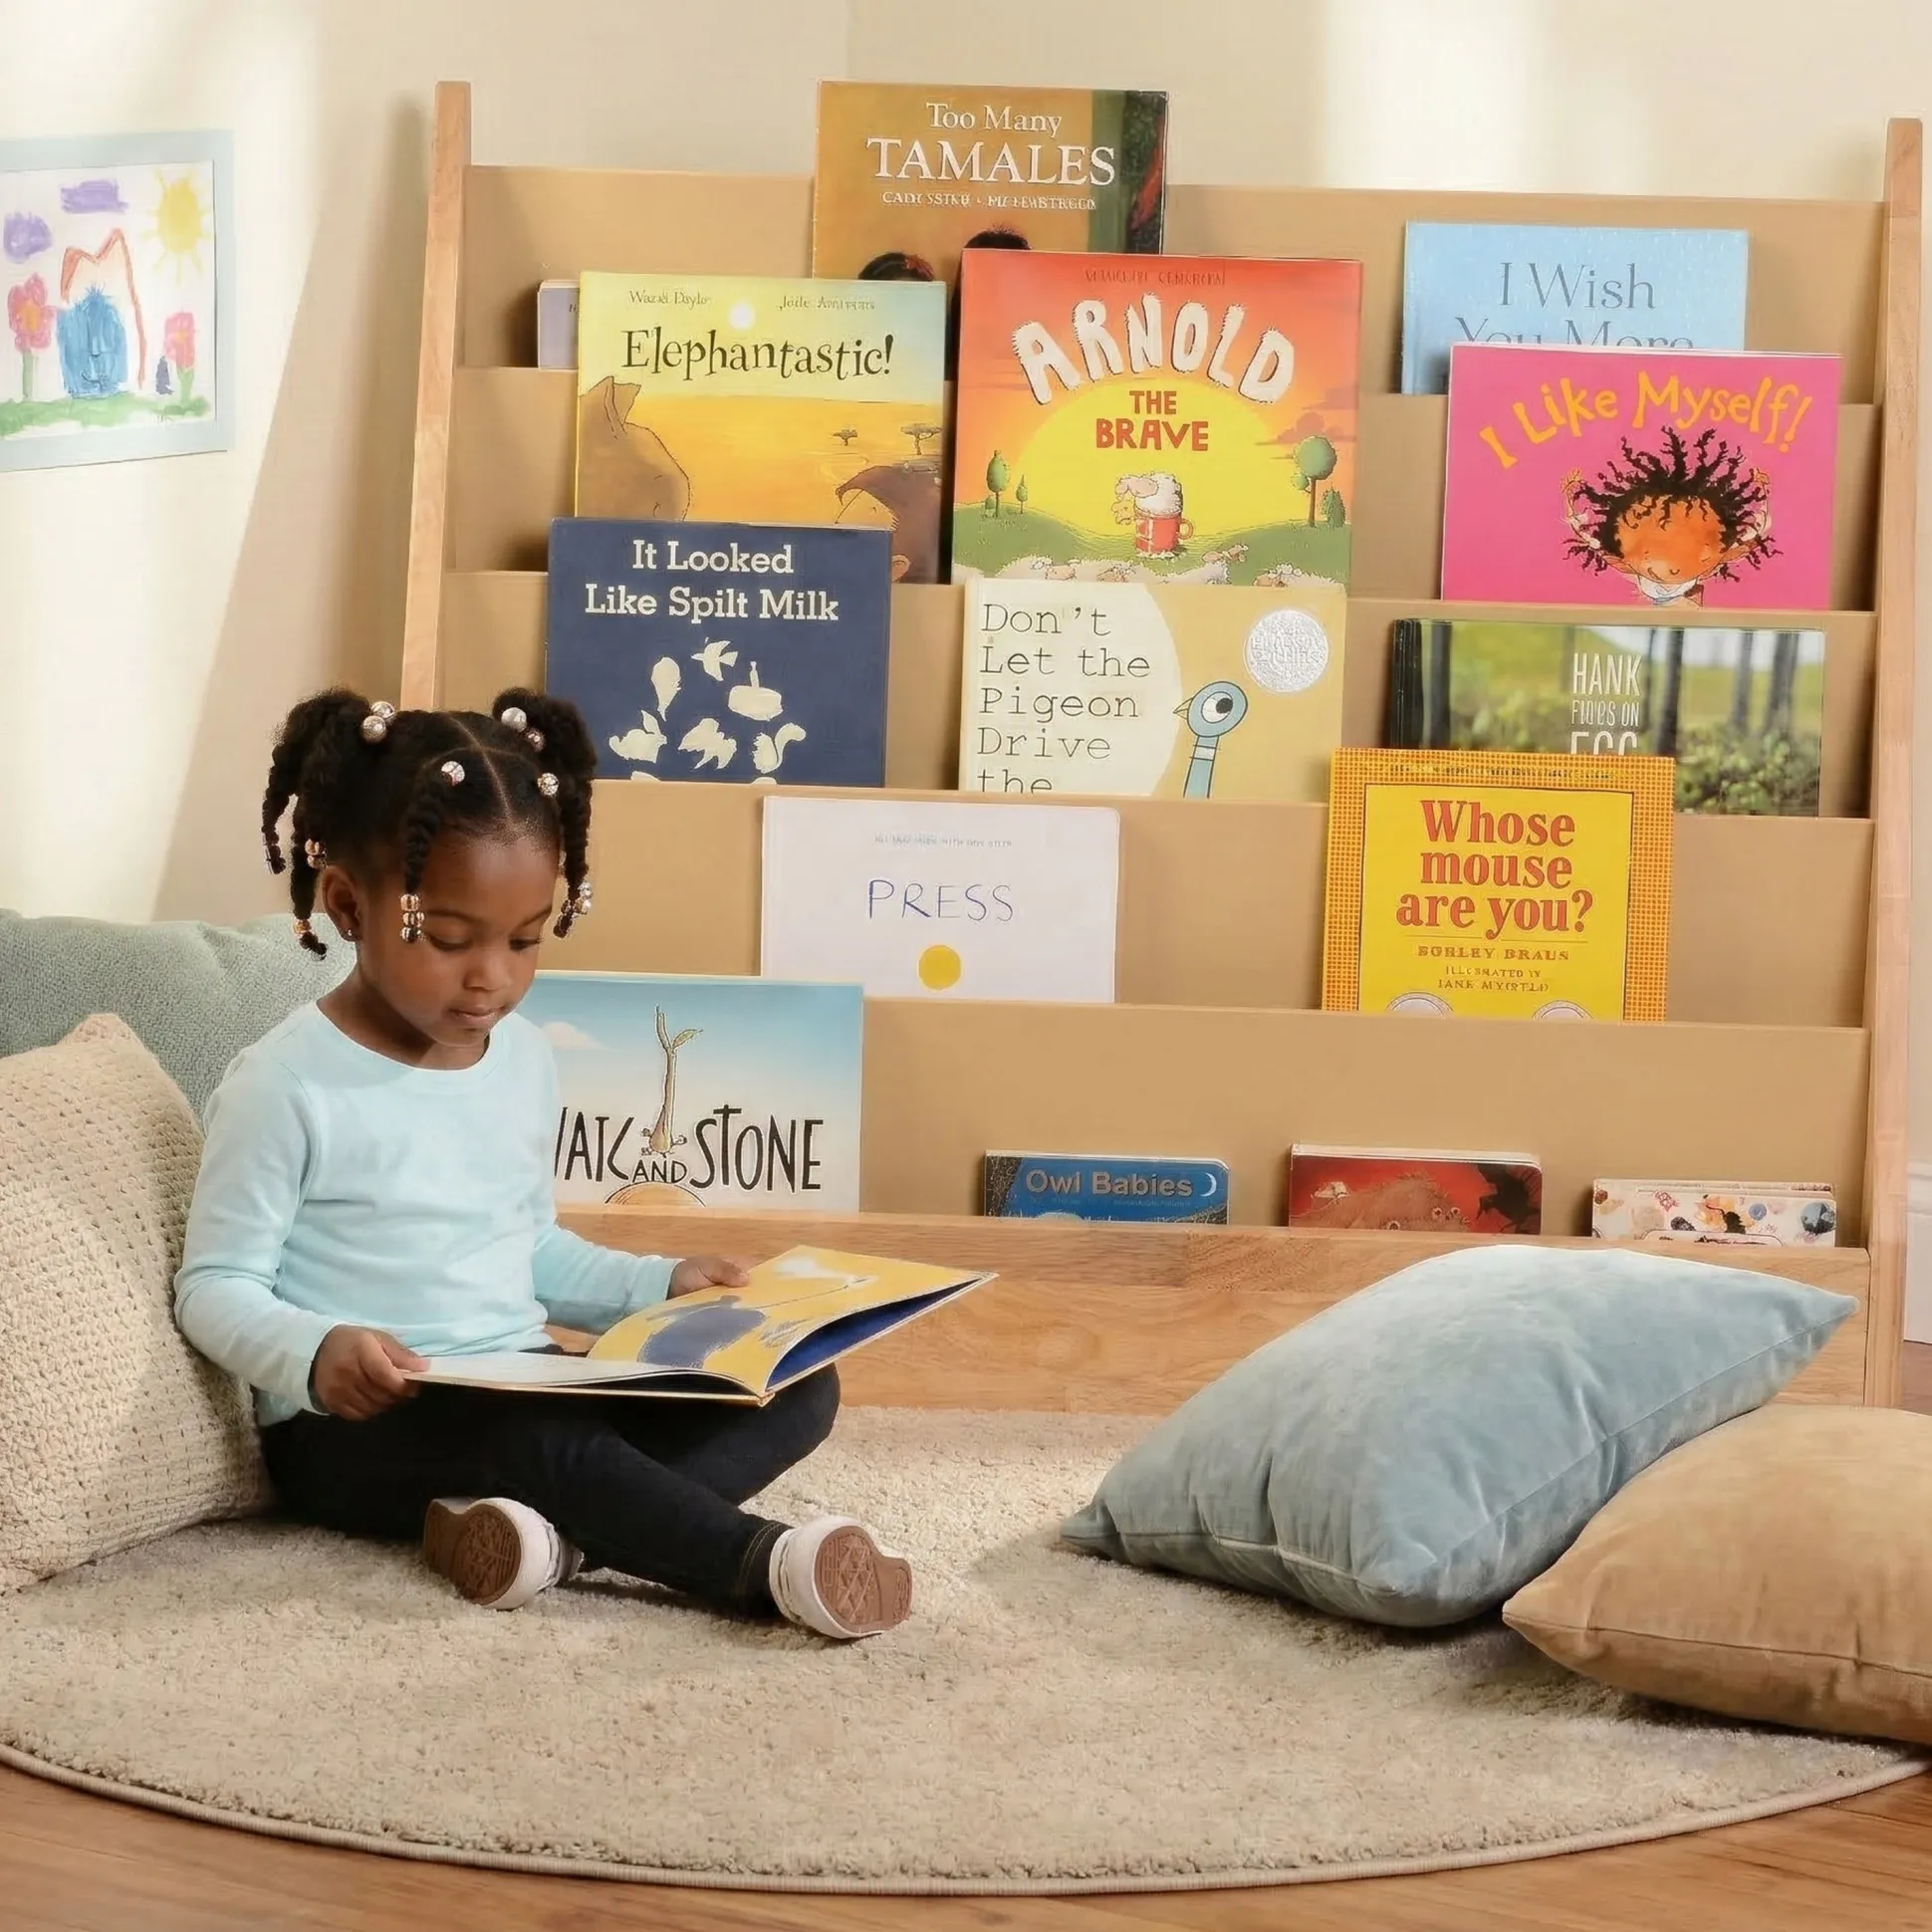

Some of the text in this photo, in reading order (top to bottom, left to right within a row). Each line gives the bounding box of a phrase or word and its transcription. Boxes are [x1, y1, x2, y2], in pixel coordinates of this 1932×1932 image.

[926, 102, 1062, 137] Too Many
[866, 137, 1115, 186] TAMALES
[1499, 262, 1656, 310] I Wish
[621, 327, 895, 380] Elephantastic!
[1011, 291, 1296, 405] ARNOLD
[1128, 390, 1177, 415] THE
[1479, 369, 1813, 470] I Like Myself!
[1095, 418, 1209, 451] BRAVE
[632, 539, 794, 575] It Looked
[585, 584, 840, 624] Like Spilt Milk
[981, 604, 1111, 636] Don't
[980, 645, 1150, 678] Let the
[1573, 652, 1642, 696] HANK
[979, 685, 1139, 724] Pigeon
[977, 727, 1110, 760] Drive
[978, 768, 1053, 794] the
[1419, 800, 1575, 847] Whose
[1420, 851, 1572, 889] mouse
[867, 878, 1014, 922] PRESS
[1395, 889, 1593, 941] are you?
[632, 1159, 689, 1184] AND
[689, 1103, 824, 1193] STONE
[1026, 1169, 1193, 1197] Owl Babies
